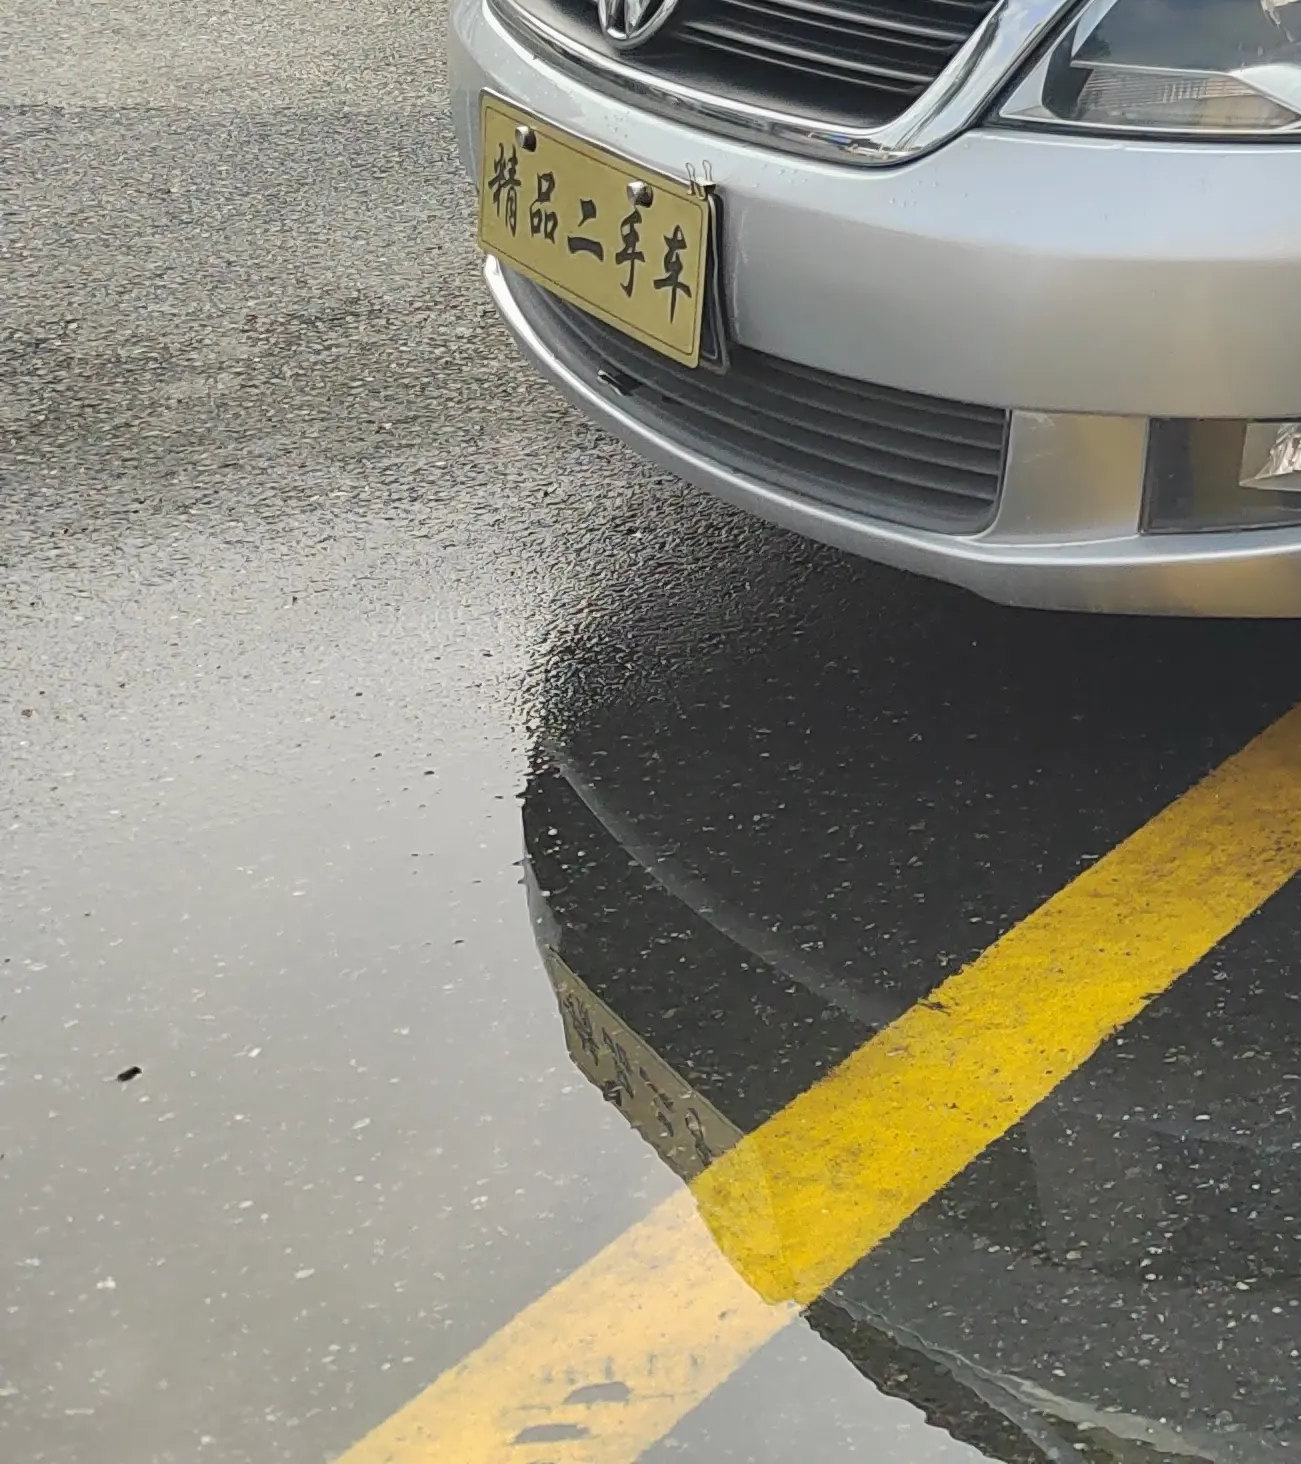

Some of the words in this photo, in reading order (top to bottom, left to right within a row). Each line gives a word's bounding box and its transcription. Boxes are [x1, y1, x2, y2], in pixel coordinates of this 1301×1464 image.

[487, 141, 692, 324] 精品二手车
